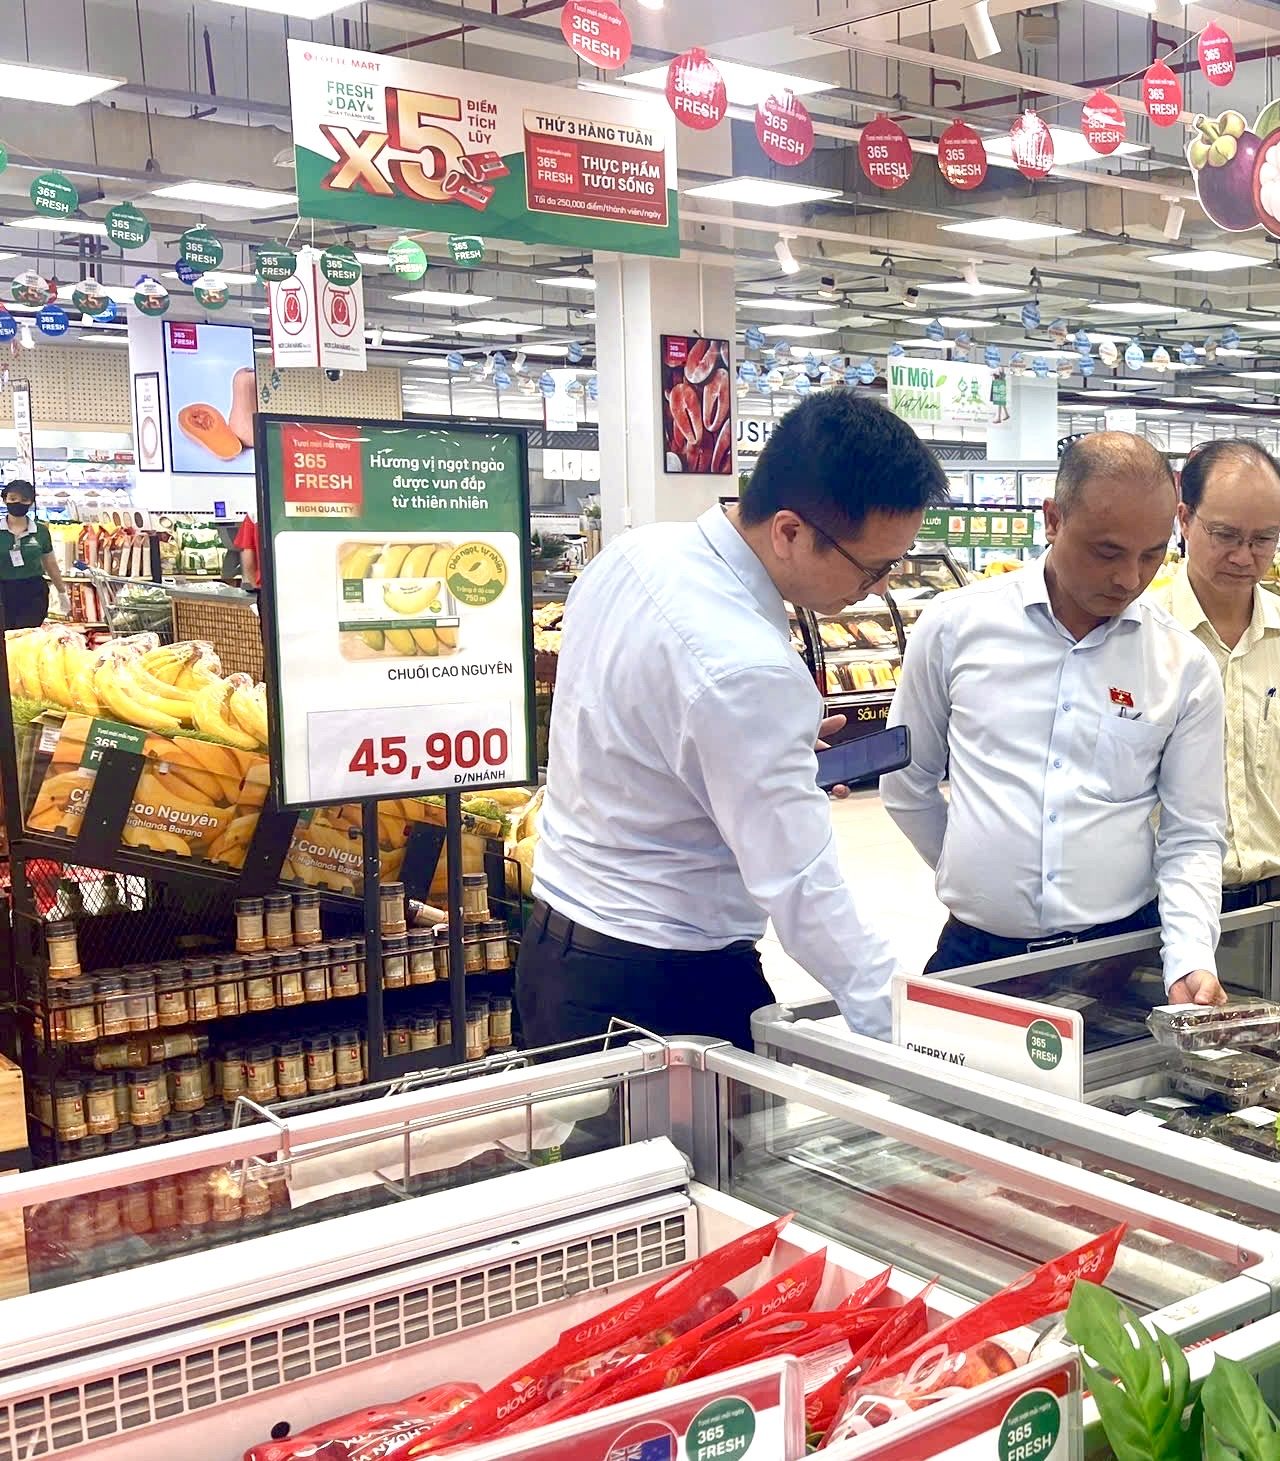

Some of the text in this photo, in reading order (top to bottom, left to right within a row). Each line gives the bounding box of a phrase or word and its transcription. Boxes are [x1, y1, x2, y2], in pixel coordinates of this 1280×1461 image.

[572, 15, 600, 36] 365
[572, 32, 620, 61] FRESH
[1203, 47, 1221, 62] 365
[351, 59, 382, 72] MART
[1206, 61, 1234, 77] FRESH
[327, 80, 374, 100] FRESH
[1148, 88, 1165, 101] 365
[336, 96, 366, 113] DAY
[466, 99, 498, 116] ĐIỂM
[674, 98, 719, 121] FRESH
[1149, 103, 1178, 116] FRESH
[467, 115, 497, 131] TÍCH
[764, 114, 788, 132] 365
[468, 130, 493, 146] LŨY
[536, 116, 653, 146] THỨ 3 HÀNG TUẦN
[1089, 132, 1120, 144] FRESH
[763, 130, 805, 156] FRESH
[867, 145, 889, 159] 365
[945, 148, 966, 161] 365
[536, 156, 558, 169] 365
[581, 155, 661, 179] THỰC PHẨM
[869, 162, 908, 177] FRESH
[537, 170, 574, 185] FRESH
[582, 173, 655, 195] TƯƠI SỐNG
[36, 186, 57, 199] 365
[36, 197, 70, 214] FRESH
[111, 219, 130, 230] 365
[111, 229, 144, 243] FRESH
[185, 242, 204, 253] 365
[452, 241, 468, 251] 365
[185, 252, 217, 265] FRESH
[261, 256, 279, 266] 365
[455, 250, 482, 260] FRESH
[261, 266, 291, 277] FRESH
[326, 259, 343, 269] 365
[327, 269, 356, 280] FRESH
[41, 323, 65, 331] FRESH
[173, 338, 195, 346] FRESH
[890, 365, 935, 391] Vì Một
[292, 438, 310, 448] Tươi
[293, 452, 327, 469] 365
[369, 453, 505, 474] Hương vị ngọt ngào
[294, 473, 353, 490] FRESH
[392, 475, 486, 493] được vun đắp
[295, 505, 354, 513] HIGH QUALITY
[391, 495, 489, 510] từ thiên nhiên
[387, 660, 513, 681] CHUỐI CAO NGUYÊN
[857, 706, 878, 721] Sầu
[348, 727, 509, 780] 45,900
[453, 769, 506, 784] Đ/NHÁNH
[156, 801, 219, 829] Nguyên
[168, 824, 204, 838] Banana
[297, 839, 326, 858] Cao
[1031, 1035, 1047, 1049] 365
[1031, 1048, 1058, 1064] FRESH
[697, 1426, 725, 1446] 365
[1007, 1421, 1033, 1447] 365
[697, 1434, 746, 1461] FRESH
[1007, 1432, 1052, 1461] FRESH
